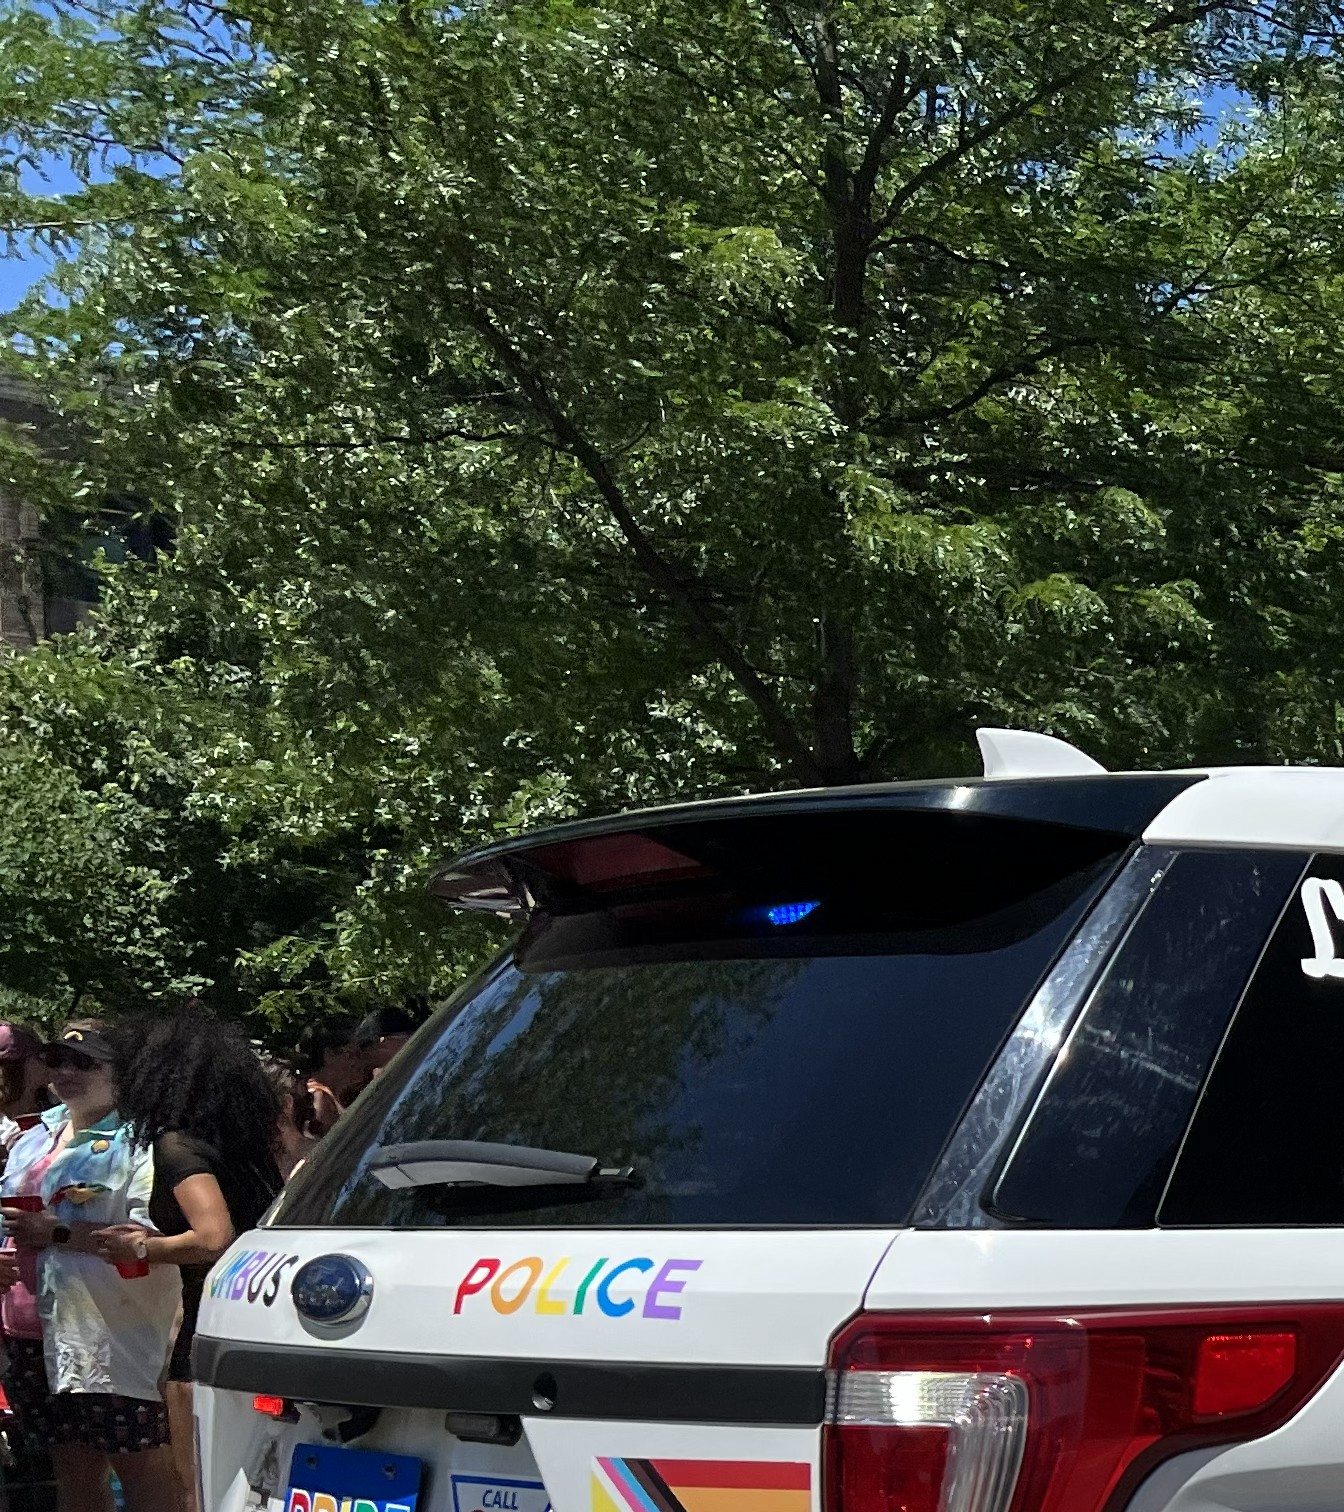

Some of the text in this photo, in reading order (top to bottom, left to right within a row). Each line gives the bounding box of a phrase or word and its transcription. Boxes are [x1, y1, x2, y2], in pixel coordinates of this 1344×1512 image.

[210, 1250, 703, 1320] UMBUS POLICE
[482, 1489, 519, 1511] CALL
